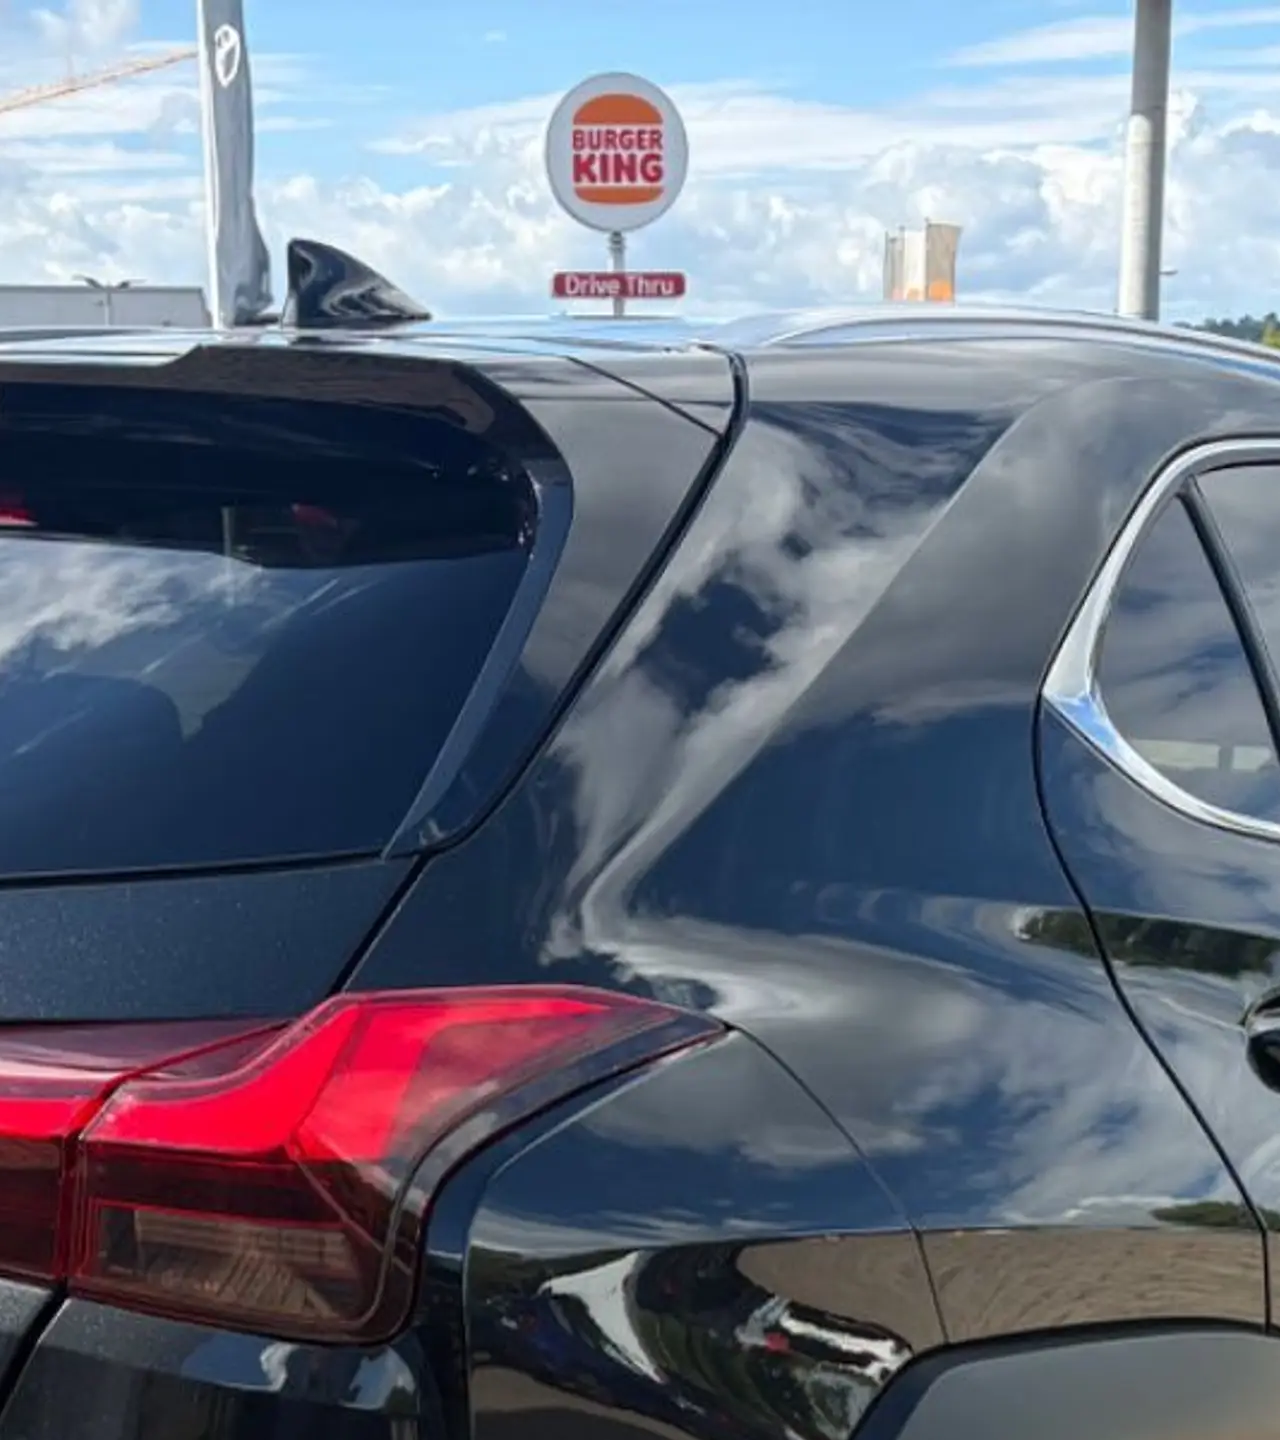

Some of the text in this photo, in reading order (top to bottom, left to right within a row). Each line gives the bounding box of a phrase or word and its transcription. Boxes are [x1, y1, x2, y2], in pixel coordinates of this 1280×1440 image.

[572, 129, 663, 150] BURGER
[573, 154, 663, 183] KING
[565, 275, 674, 295] Drive Thru
